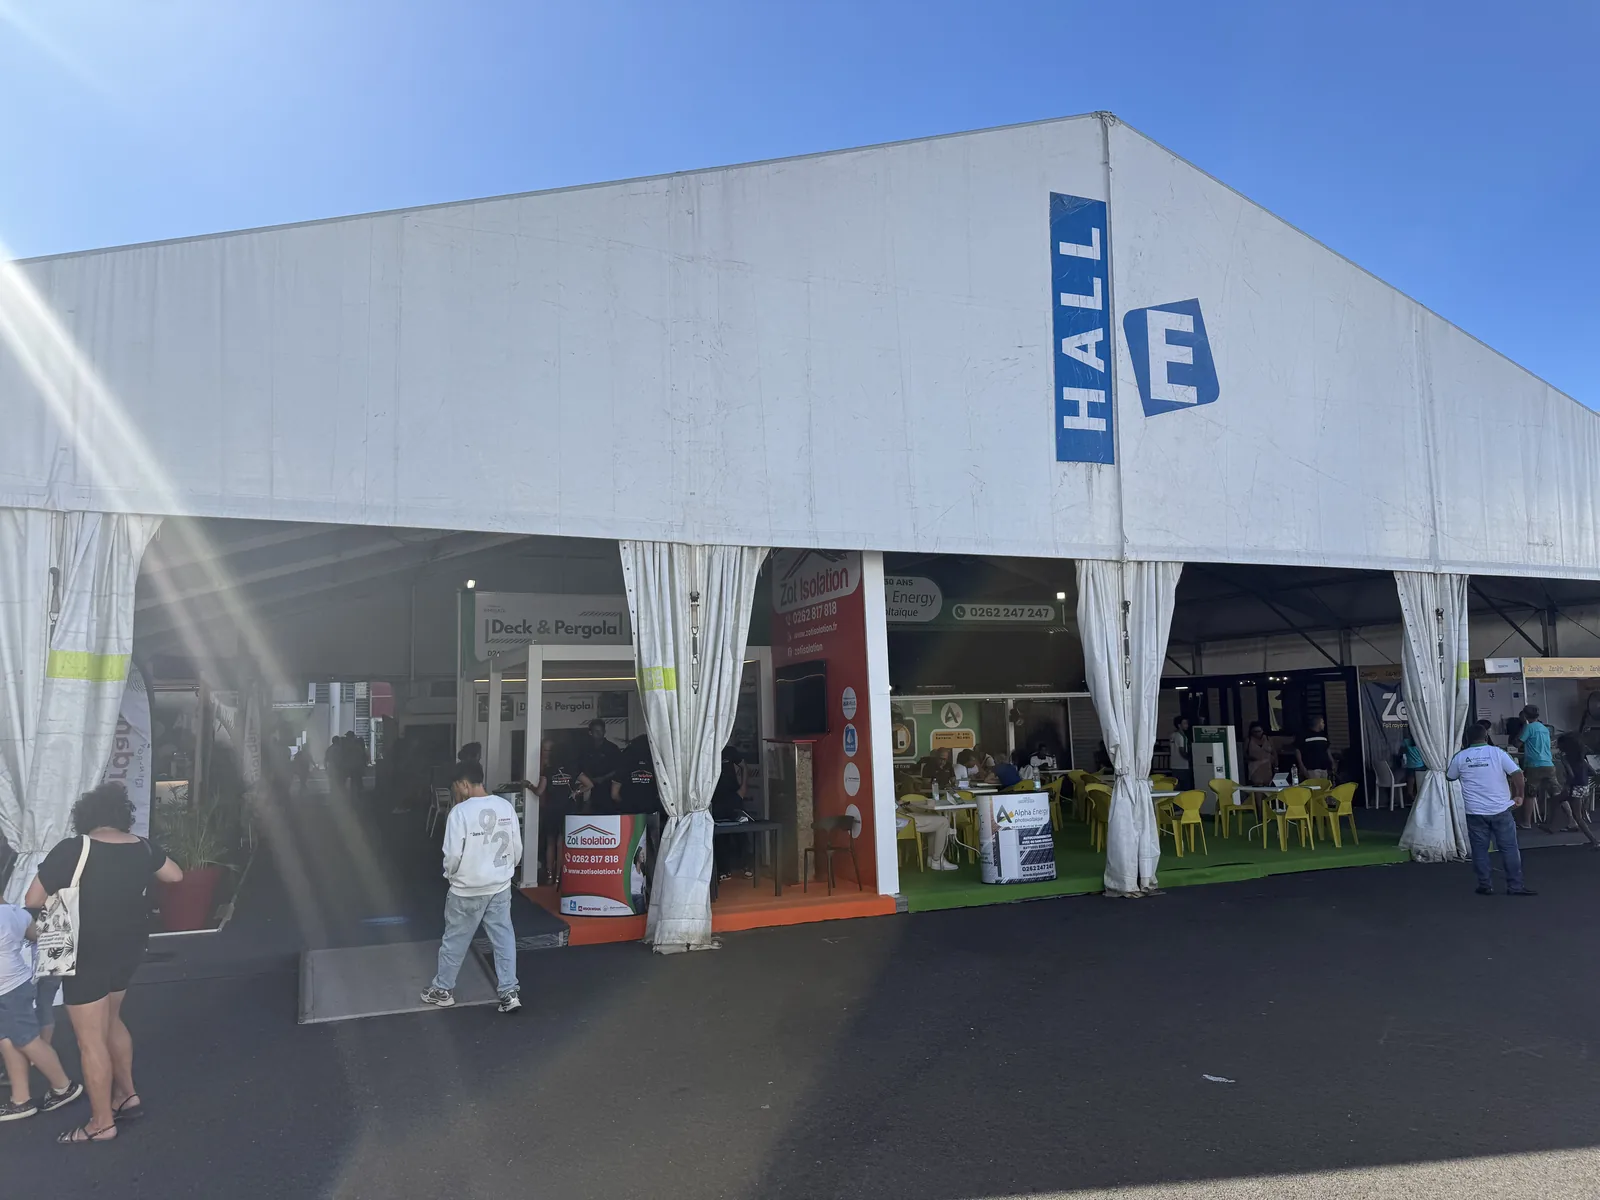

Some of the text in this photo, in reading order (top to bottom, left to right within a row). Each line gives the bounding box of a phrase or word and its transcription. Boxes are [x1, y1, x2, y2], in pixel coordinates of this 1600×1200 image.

[1059, 227, 1106, 431] HALL
[1146, 309, 1198, 404] E
[780, 567, 849, 607] Zot Isolation
[892, 590, 936, 607] Energy
[793, 601, 837, 624] 0262 817 818
[886, 607, 918, 619] ltaïque
[970, 607, 1049, 618] 0262 247 247
[491, 619, 617, 639] Deck & Pergola
[555, 701, 591, 712] Pergola
[1015, 809, 1031, 817] Alpha
[567, 835, 616, 845] Zot Isolation
[572, 855, 619, 863] 0262 817 818
